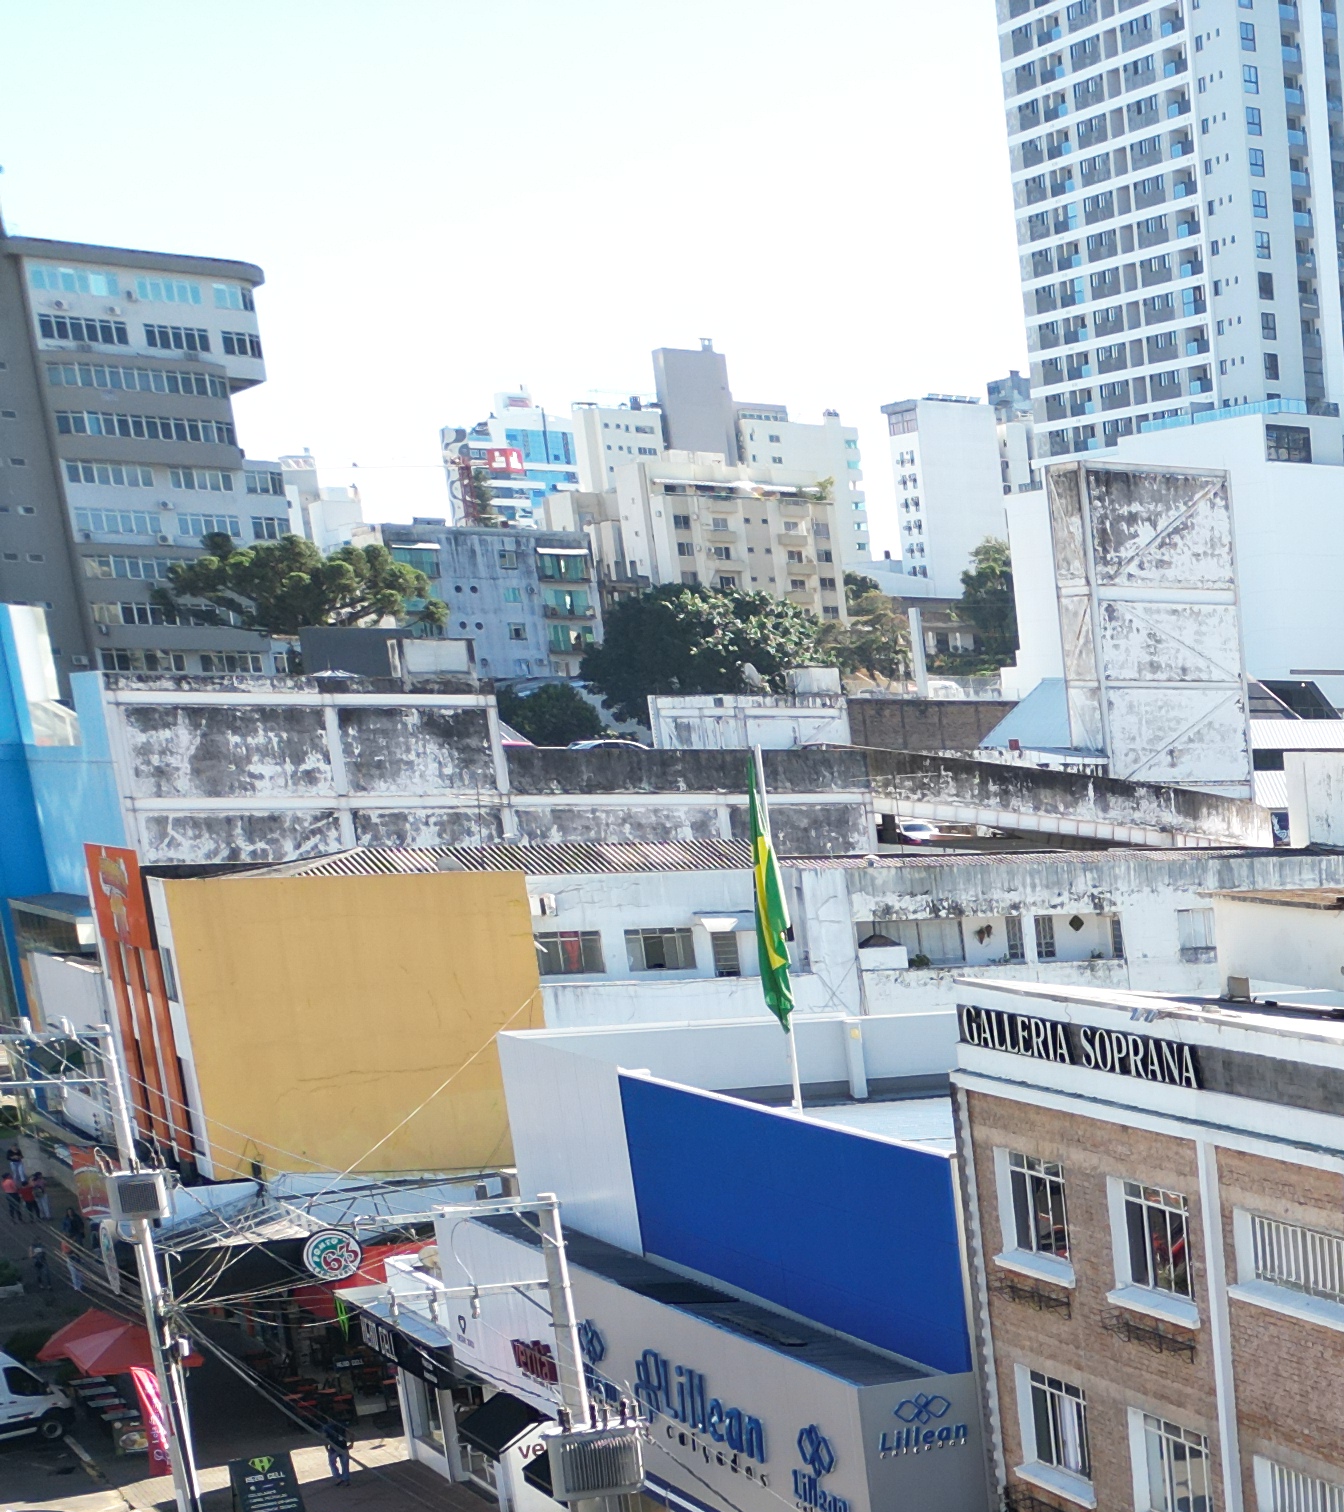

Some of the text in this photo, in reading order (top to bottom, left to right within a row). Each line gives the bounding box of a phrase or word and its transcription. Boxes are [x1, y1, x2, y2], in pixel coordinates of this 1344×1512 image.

[962, 1005, 1198, 1089] GALLERIA SOPRANA
[660, 1358, 765, 1464] Lillean
[879, 1422, 969, 1452] Lillean
